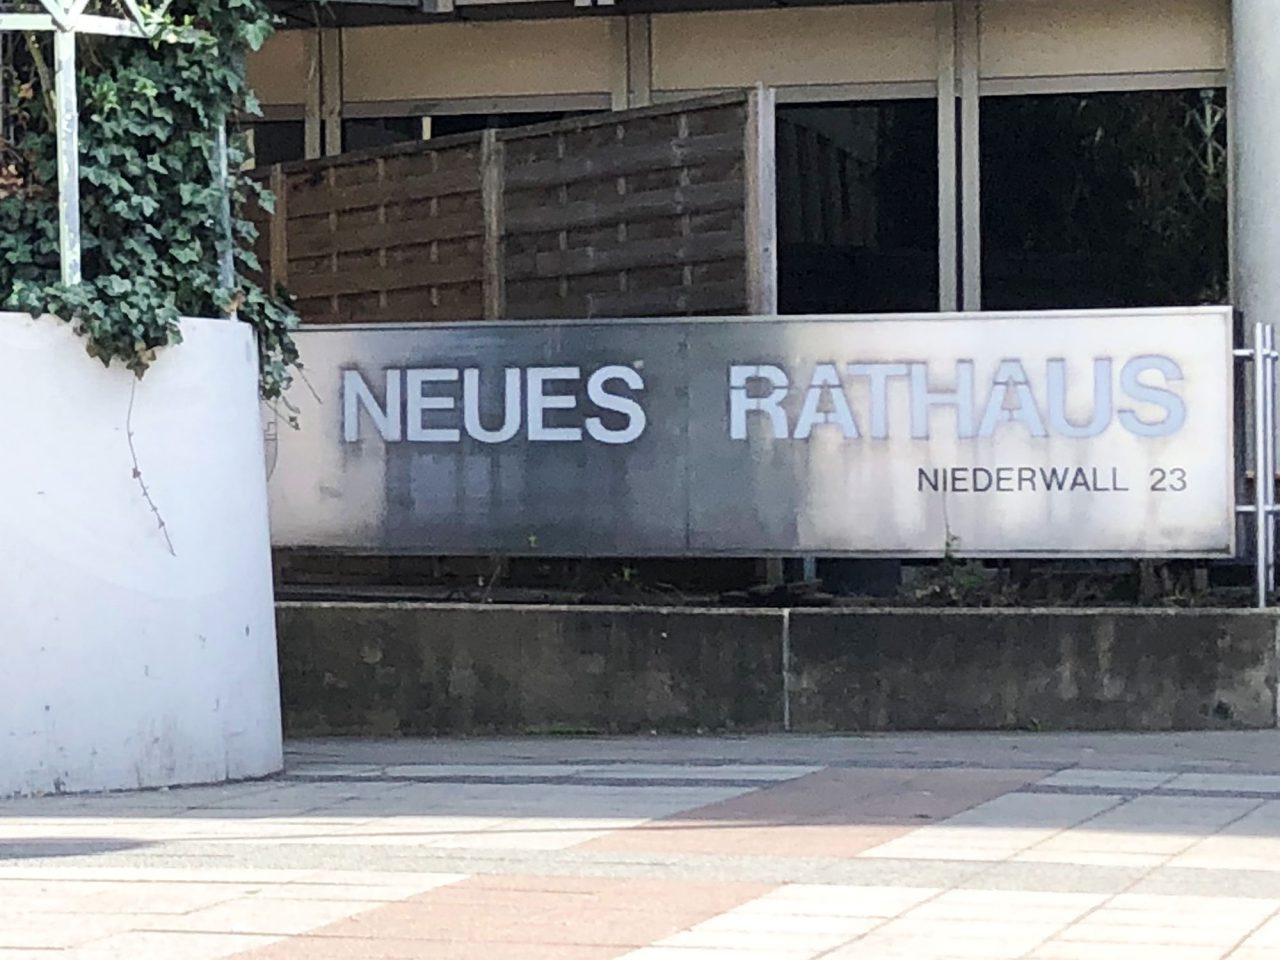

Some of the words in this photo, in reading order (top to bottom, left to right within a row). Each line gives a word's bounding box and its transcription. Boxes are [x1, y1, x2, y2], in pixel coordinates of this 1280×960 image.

[343, 365, 647, 443] NEUES
[729, 355, 1186, 439] RATHAUS
[918, 467, 1129, 492] NIEDERWALL
[1149, 467, 1187, 492] 23
